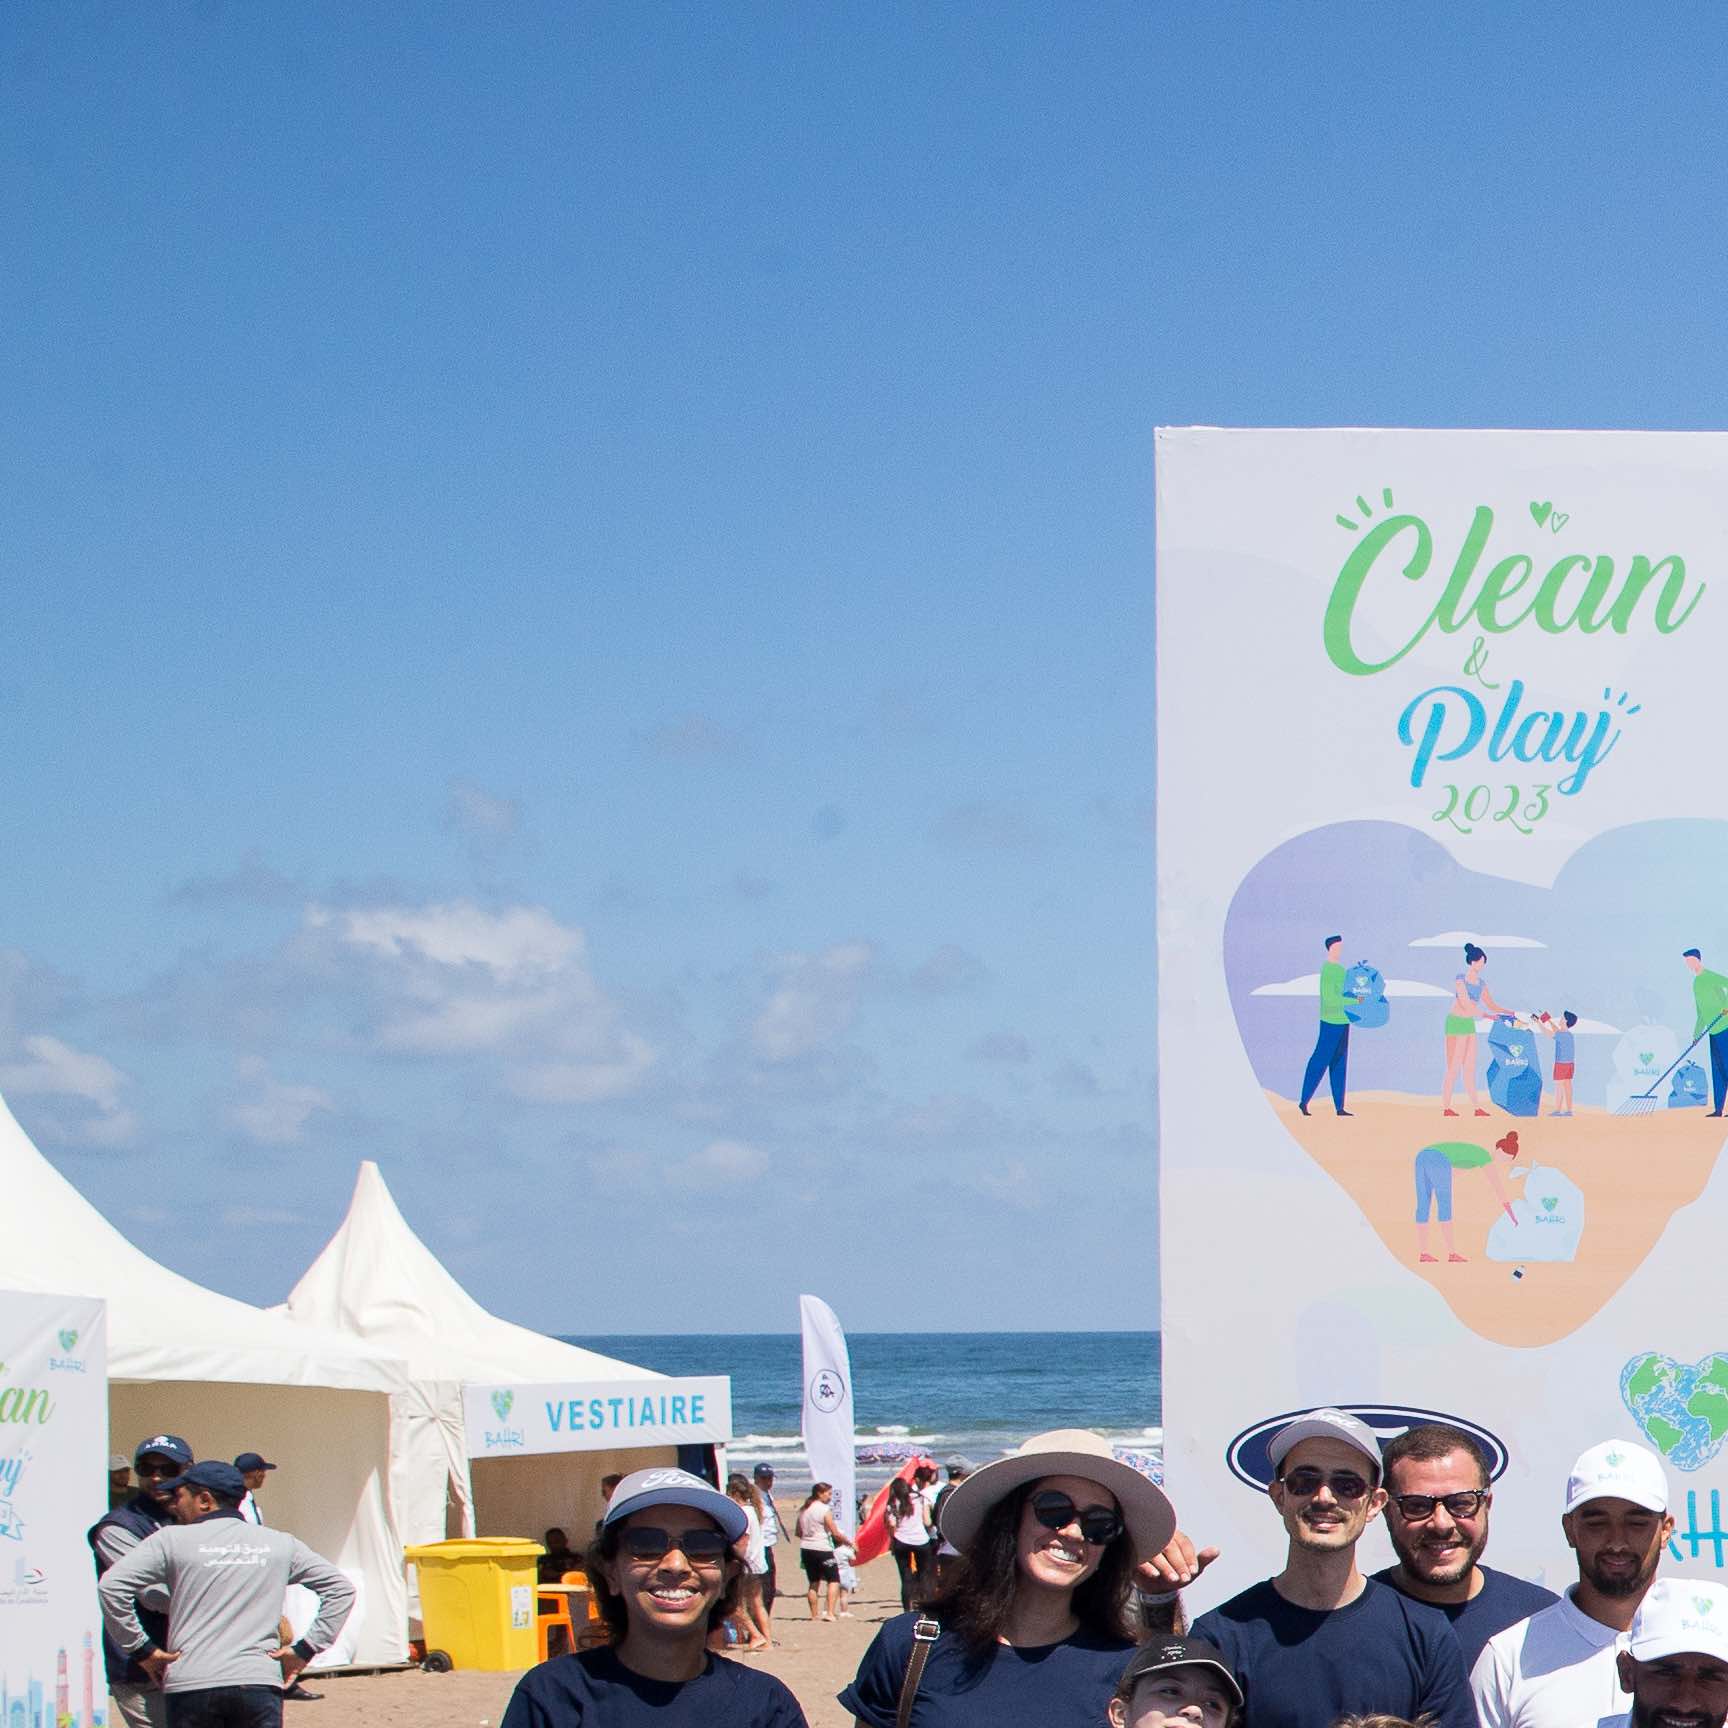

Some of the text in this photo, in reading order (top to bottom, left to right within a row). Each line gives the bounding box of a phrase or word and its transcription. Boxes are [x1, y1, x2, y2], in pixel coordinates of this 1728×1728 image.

[1323, 505, 1706, 676] Clean
[1463, 636, 1499, 689] &
[1397, 680, 1621, 795] Play
[1432, 784, 1552, 834] 2023
[546, 1395, 705, 1431] VESTIAIRE
[484, 1429, 524, 1449] BAHRI
